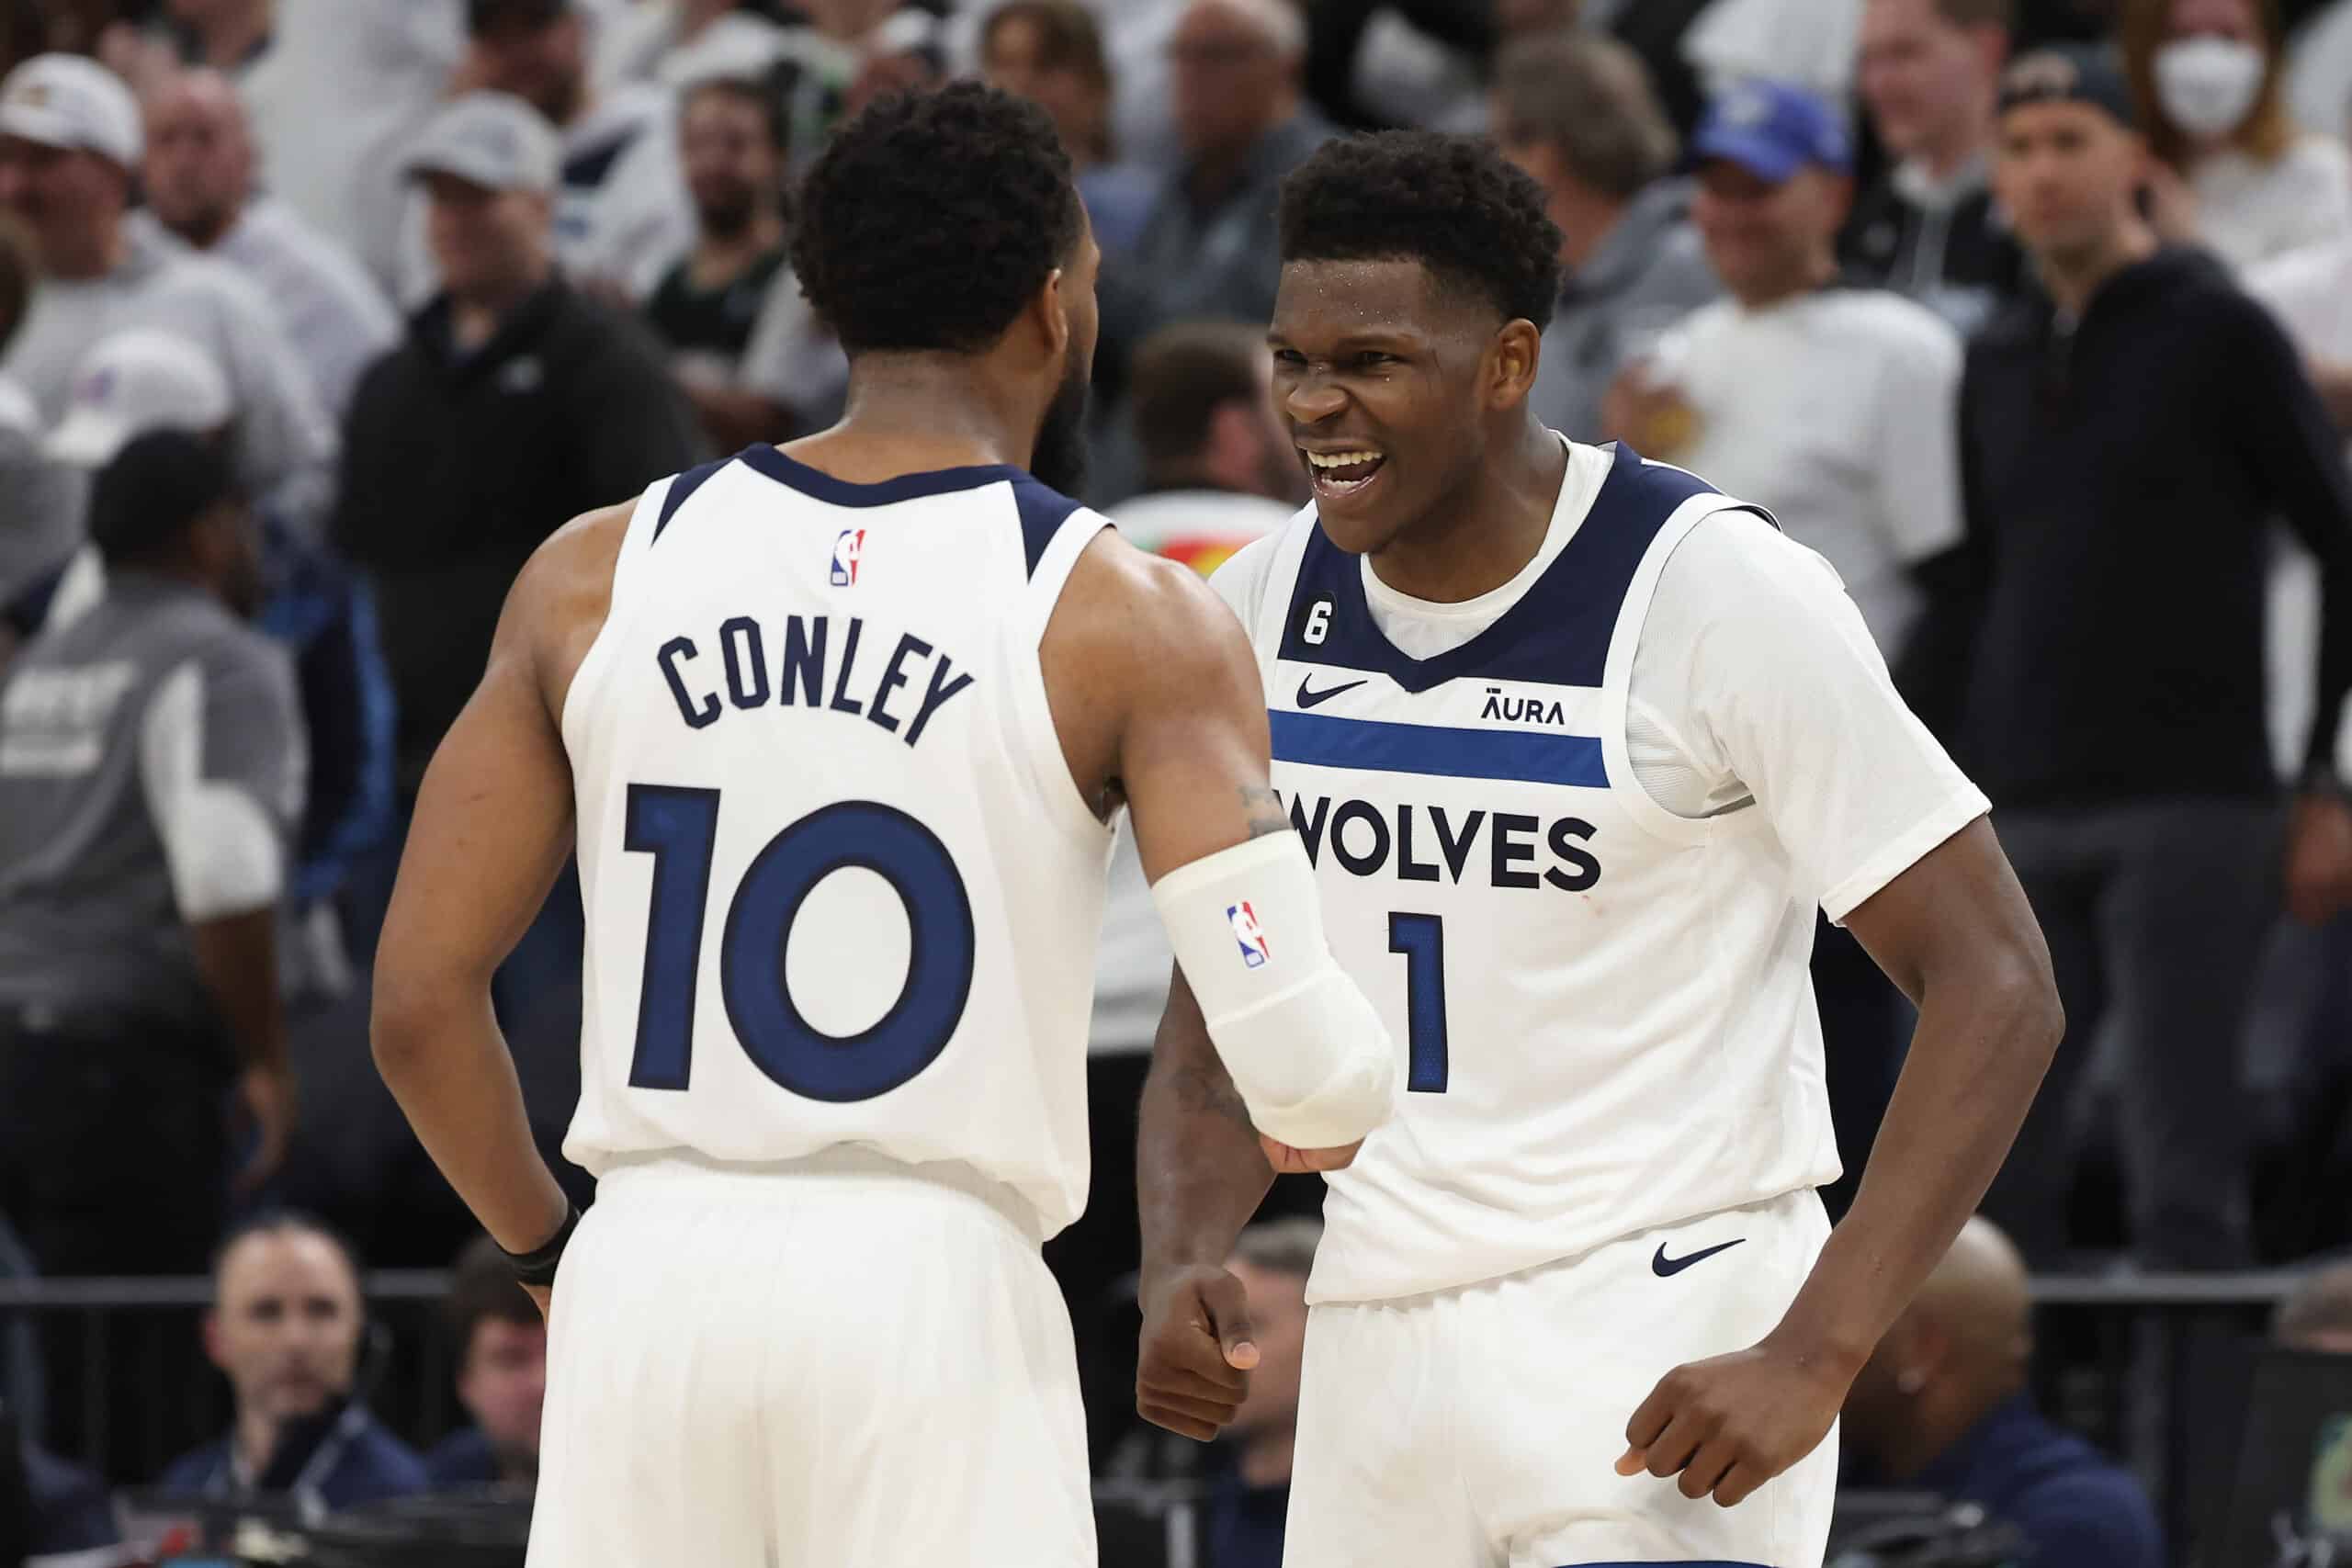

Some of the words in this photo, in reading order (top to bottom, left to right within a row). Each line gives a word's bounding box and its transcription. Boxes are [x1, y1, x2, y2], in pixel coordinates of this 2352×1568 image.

[656, 615, 976, 749] CONLEY
[1303, 600, 1332, 645] 6
[1272, 790, 1602, 893] WOLVES
[623, 783, 976, 1103] 10
[1387, 910, 1449, 1094] 1
